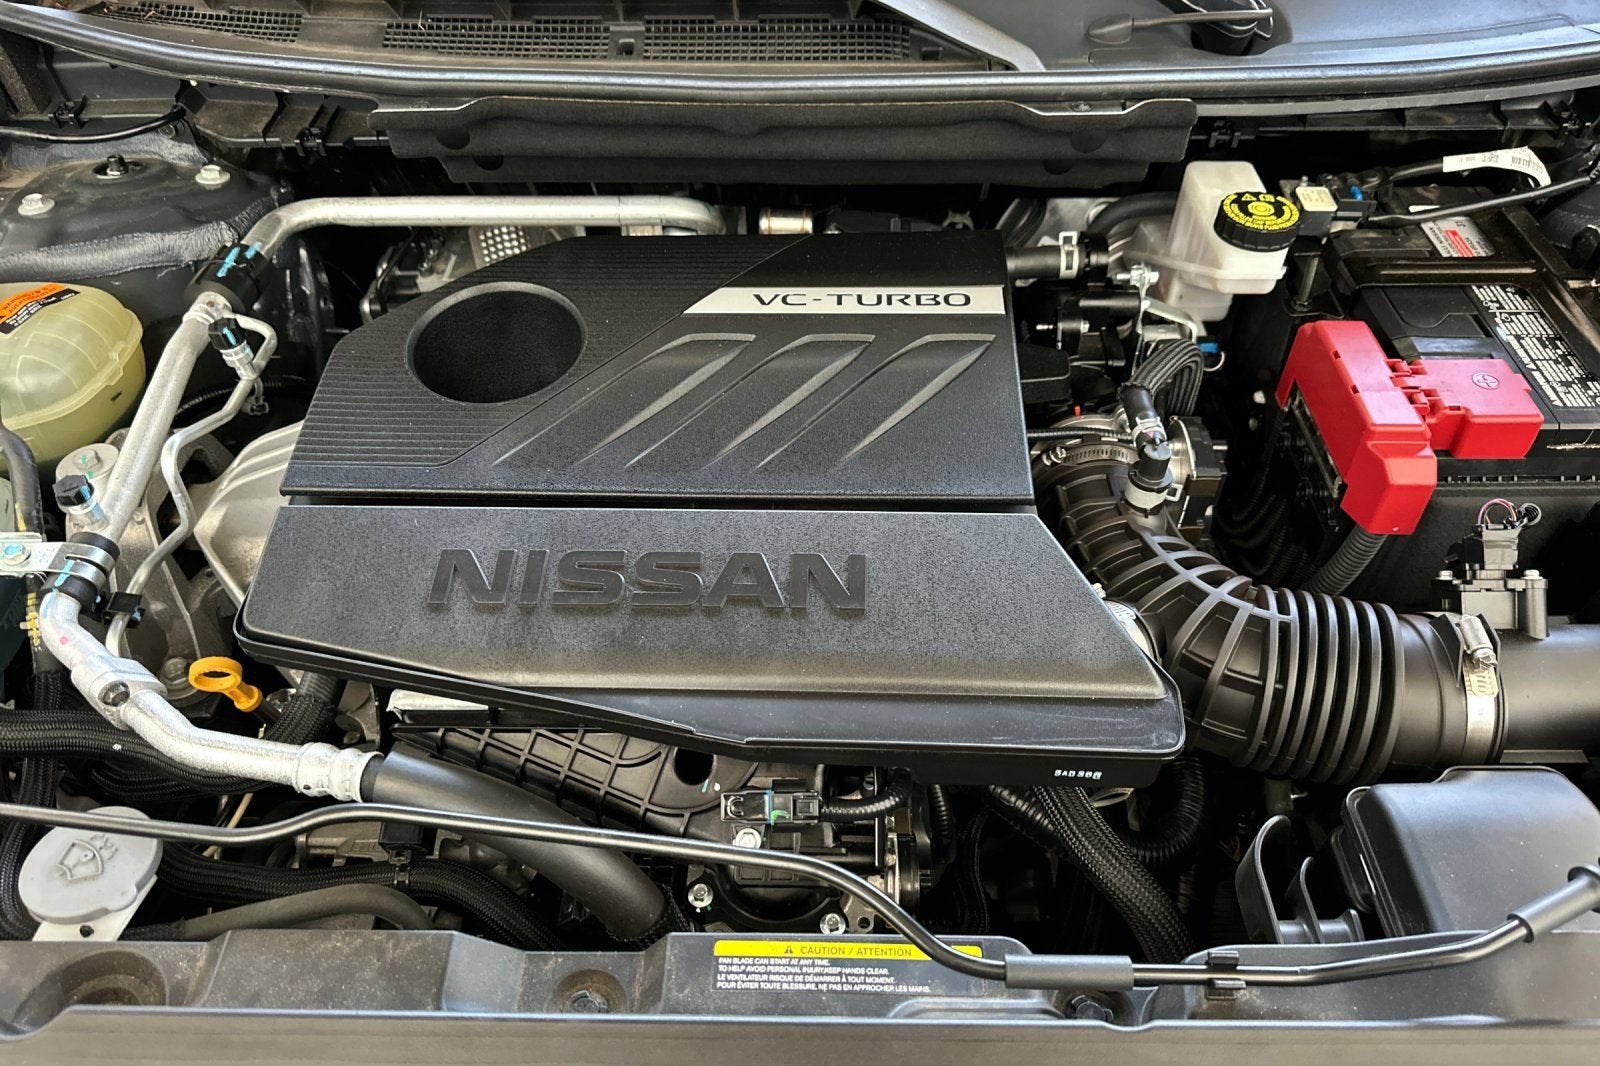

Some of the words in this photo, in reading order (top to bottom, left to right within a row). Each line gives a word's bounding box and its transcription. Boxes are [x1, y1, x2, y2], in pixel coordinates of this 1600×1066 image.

[752, 293, 971, 307] VC-TURBO
[427, 548, 867, 610] NISSAN
[800, 945, 846, 955] CAUTION
[856, 947, 912, 957] ATTENTION
[732, 957, 754, 965] BLADE
[728, 965, 746, 973] HELP
[769, 974, 793, 982] RISQUE
[853, 984, 895, 992] APPROCHER
